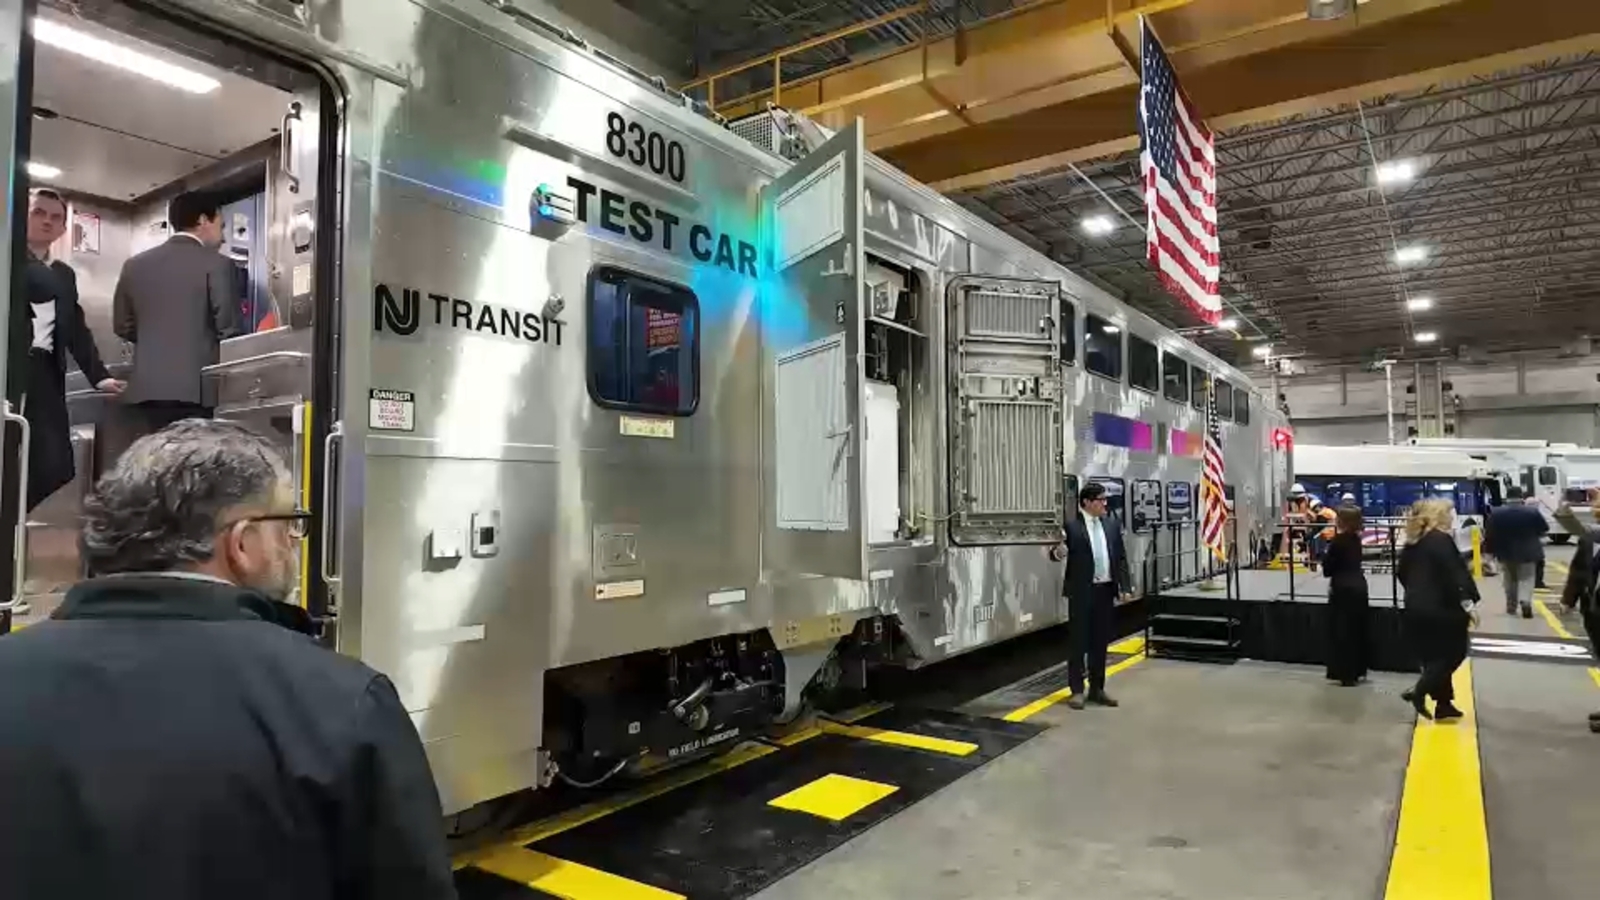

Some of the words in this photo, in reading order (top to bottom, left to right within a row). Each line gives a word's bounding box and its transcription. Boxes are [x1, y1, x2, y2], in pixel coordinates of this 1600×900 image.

[606, 111, 686, 183] 8300
[567, 176, 680, 251] TEST
[689, 224, 758, 278] CAR
[428, 292, 567, 347] TRANSIT
[373, 389, 411, 401] DANGER
